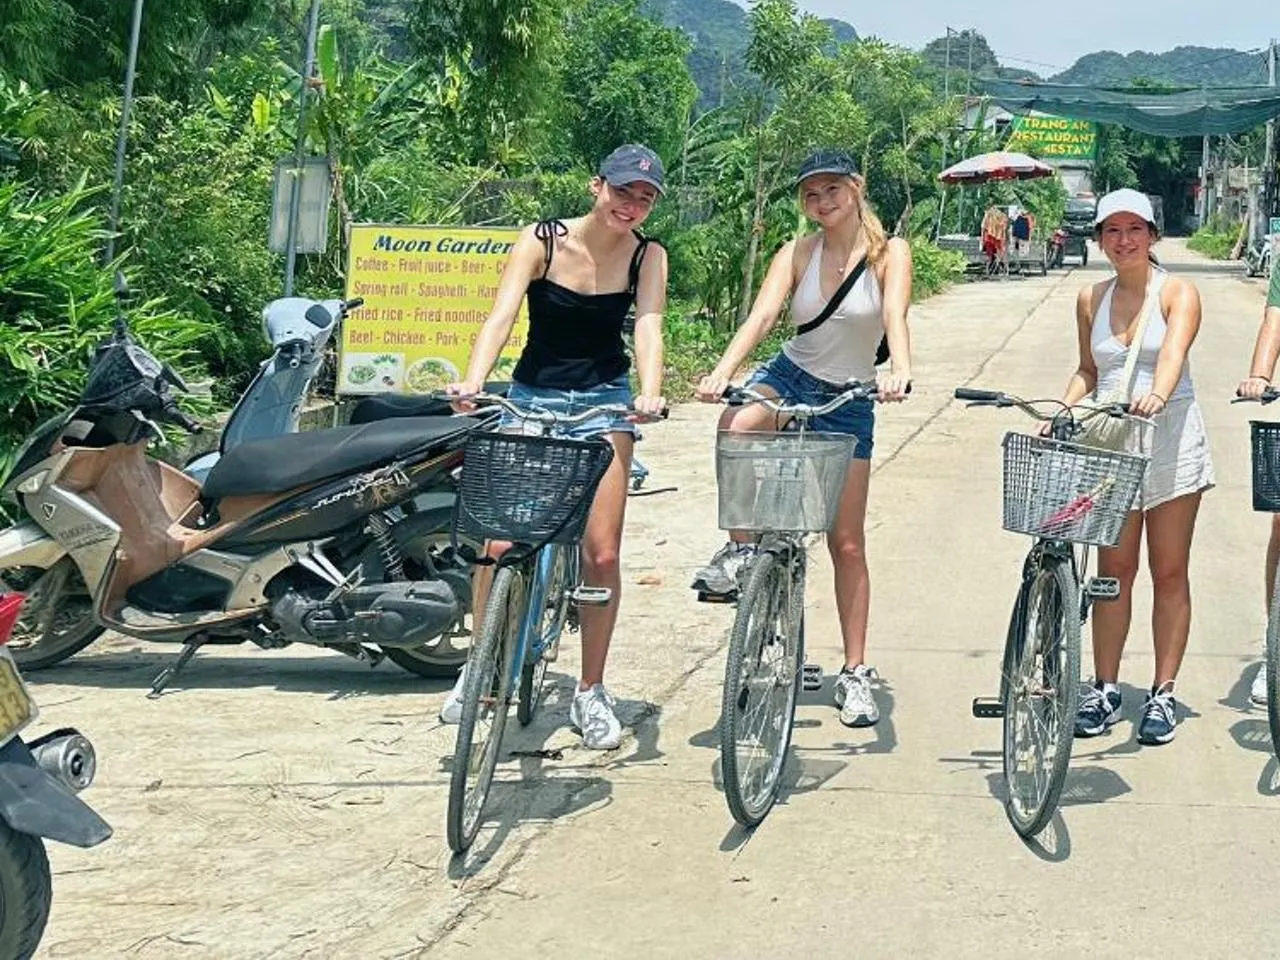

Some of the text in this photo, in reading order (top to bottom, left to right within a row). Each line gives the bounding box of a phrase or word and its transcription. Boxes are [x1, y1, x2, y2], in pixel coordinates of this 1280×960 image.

[1024, 118, 1068, 130] TRANG
[373, 234, 431, 253] Moon
[355, 256, 388, 271] Coffee
[399, 258, 422, 272] Fruit
[424, 259, 450, 274] juice
[461, 259, 485, 273] Beer
[354, 281, 386, 297] Spring
[390, 282, 408, 296] roll
[418, 282, 467, 298] Spaghetti
[382, 308, 403, 321] rice
[414, 308, 441, 322] Fried
[445, 309, 488, 324] noodles
[350, 329, 373, 344] Beef
[383, 330, 426, 345] Chicken
[436, 331, 458, 345] Pork
